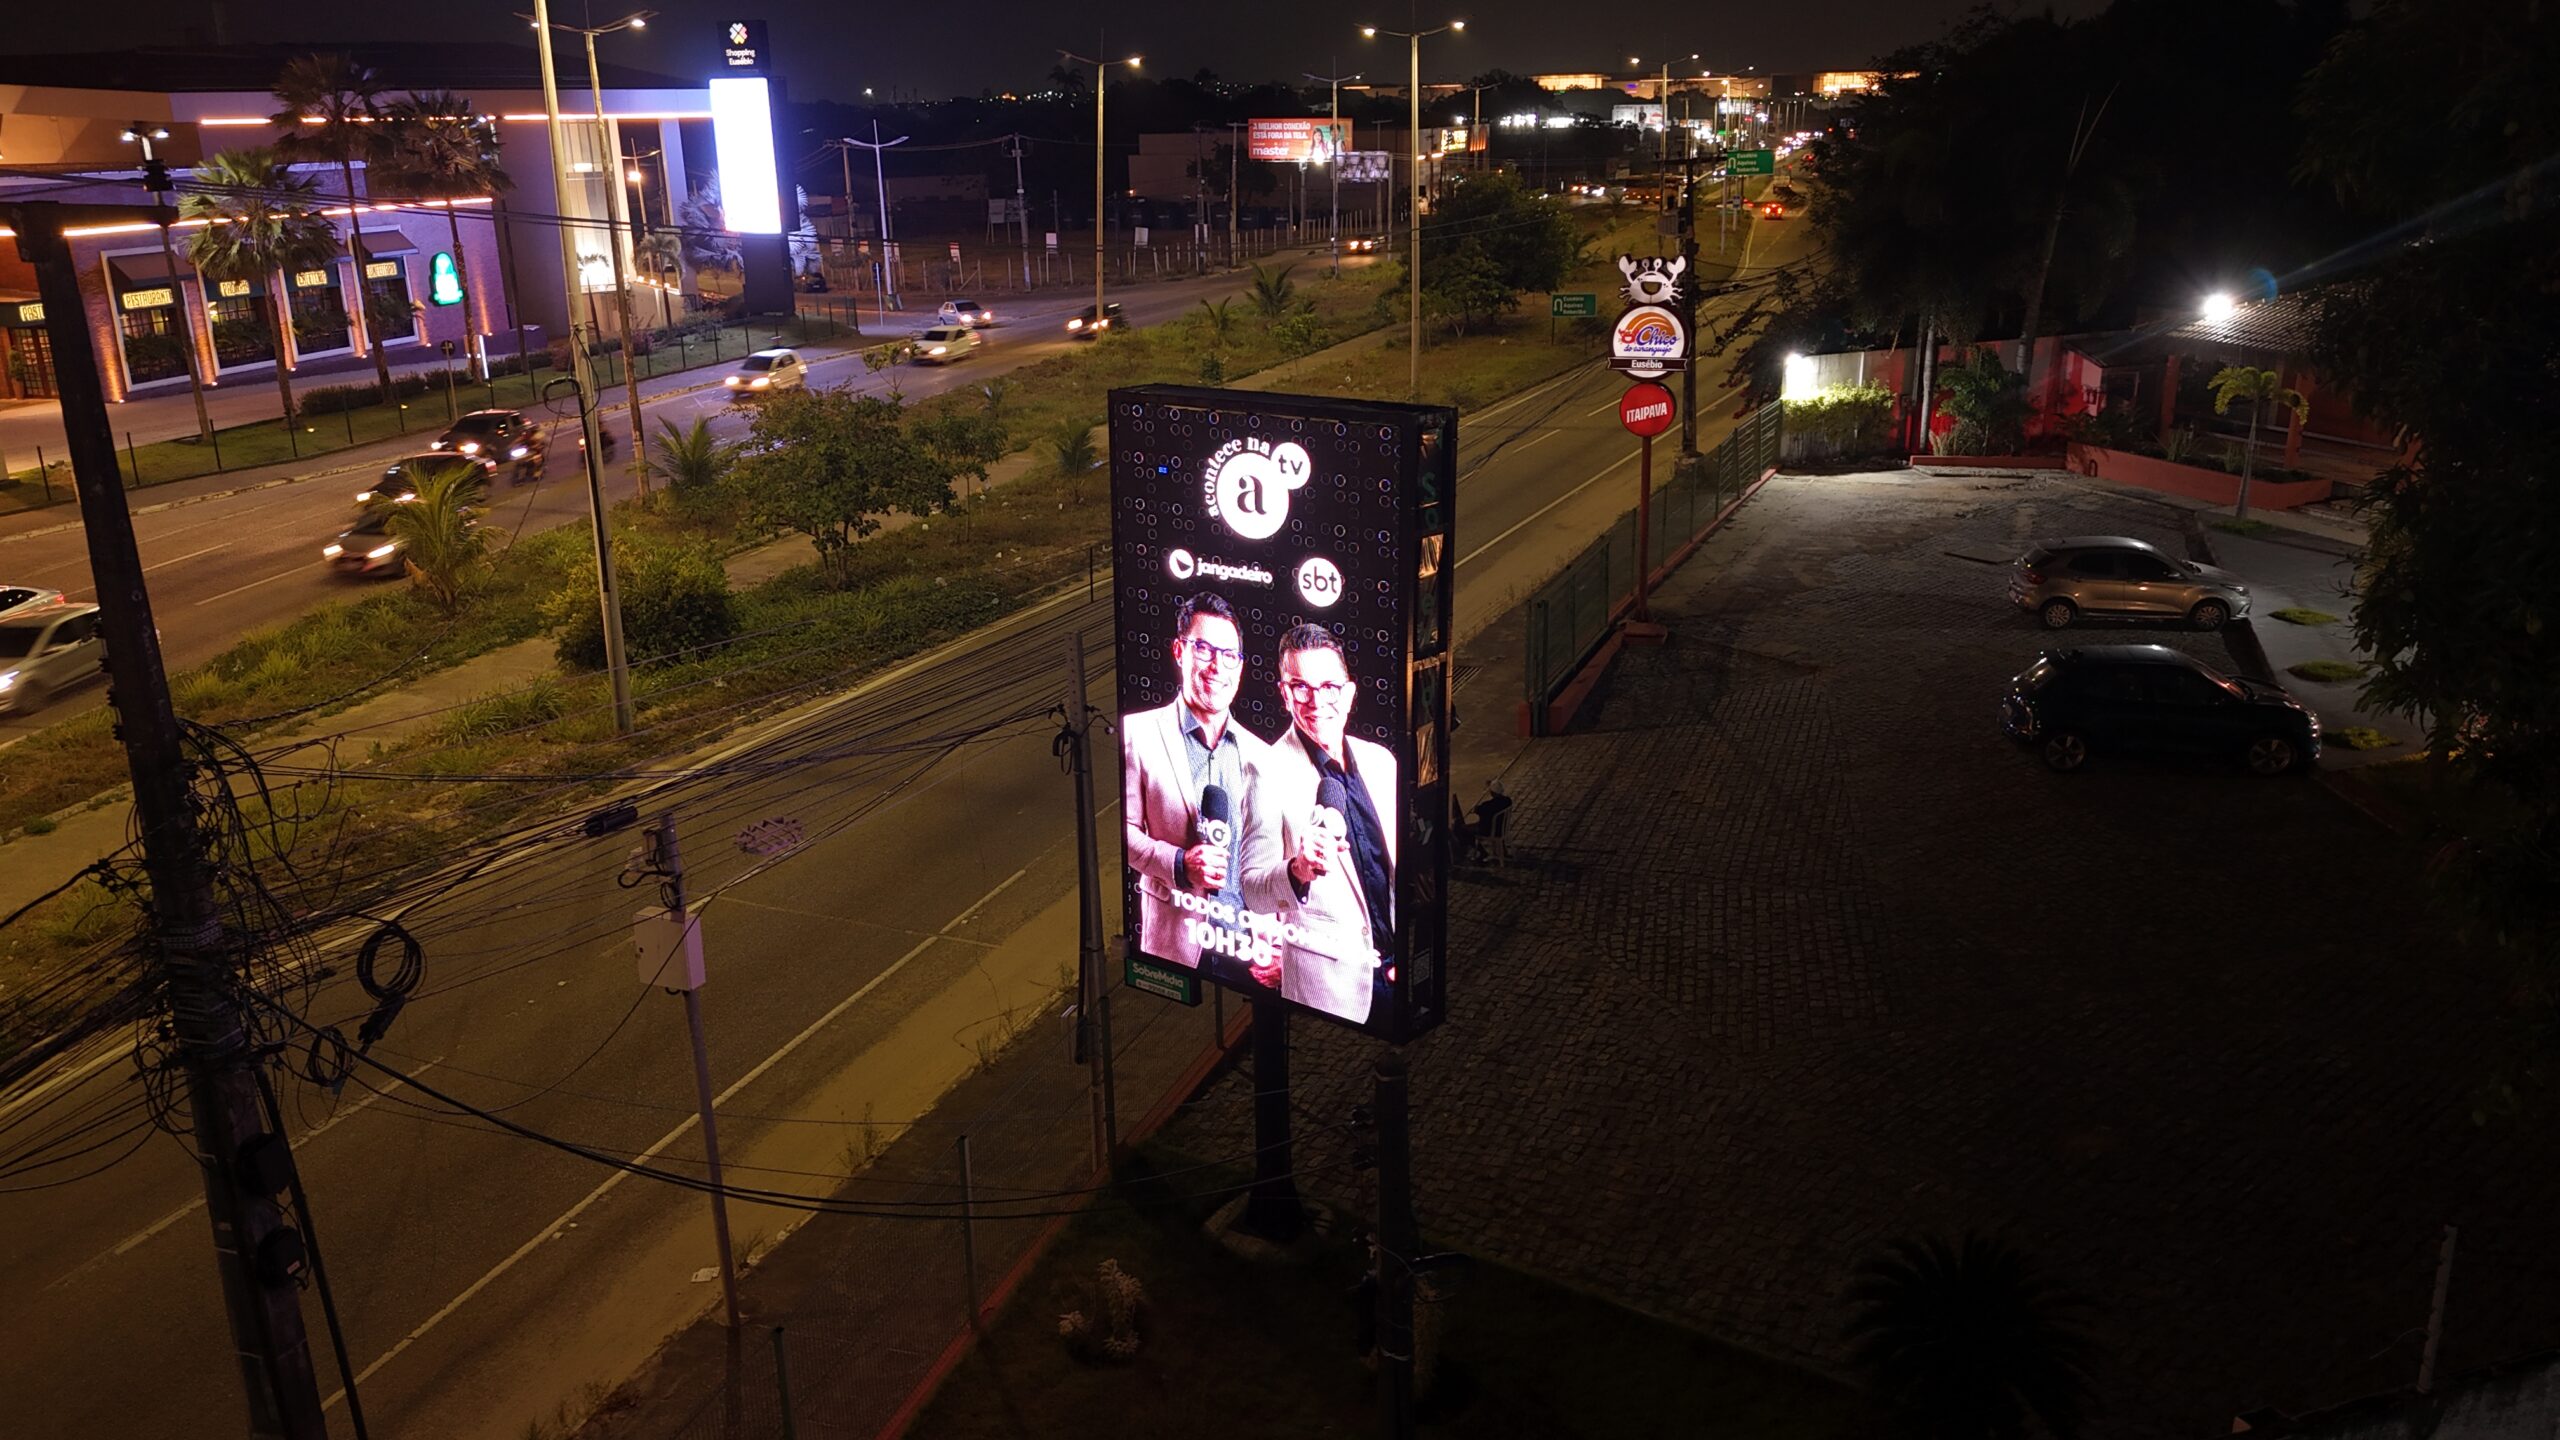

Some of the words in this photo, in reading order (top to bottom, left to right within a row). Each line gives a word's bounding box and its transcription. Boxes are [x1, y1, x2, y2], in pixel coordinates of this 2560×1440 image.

[725, 48, 756, 58] Shopping
[1253, 130, 1267, 139] ESTÁ
[1268, 131, 1283, 139] FORA
[1258, 122, 1283, 130] MELHOR
[1283, 121, 1311, 130] CONEXÃO
[1253, 147, 1289, 156] master
[1636, 325, 1679, 345] Chico
[1623, 344, 1633, 352] do
[1631, 359, 1663, 369] Eusébio
[1626, 402, 1667, 423] ITAIPAVA
[1278, 454, 1303, 476] tv
[1204, 437, 1244, 520] acontece
[1246, 436, 1270, 456] na
[1236, 474, 1267, 516] a
[1197, 557, 1272, 584] jangadeiro
[1302, 565, 1338, 594] sbt
[1171, 888, 1237, 925] TODOS
[1183, 917, 1274, 968] 10H30
